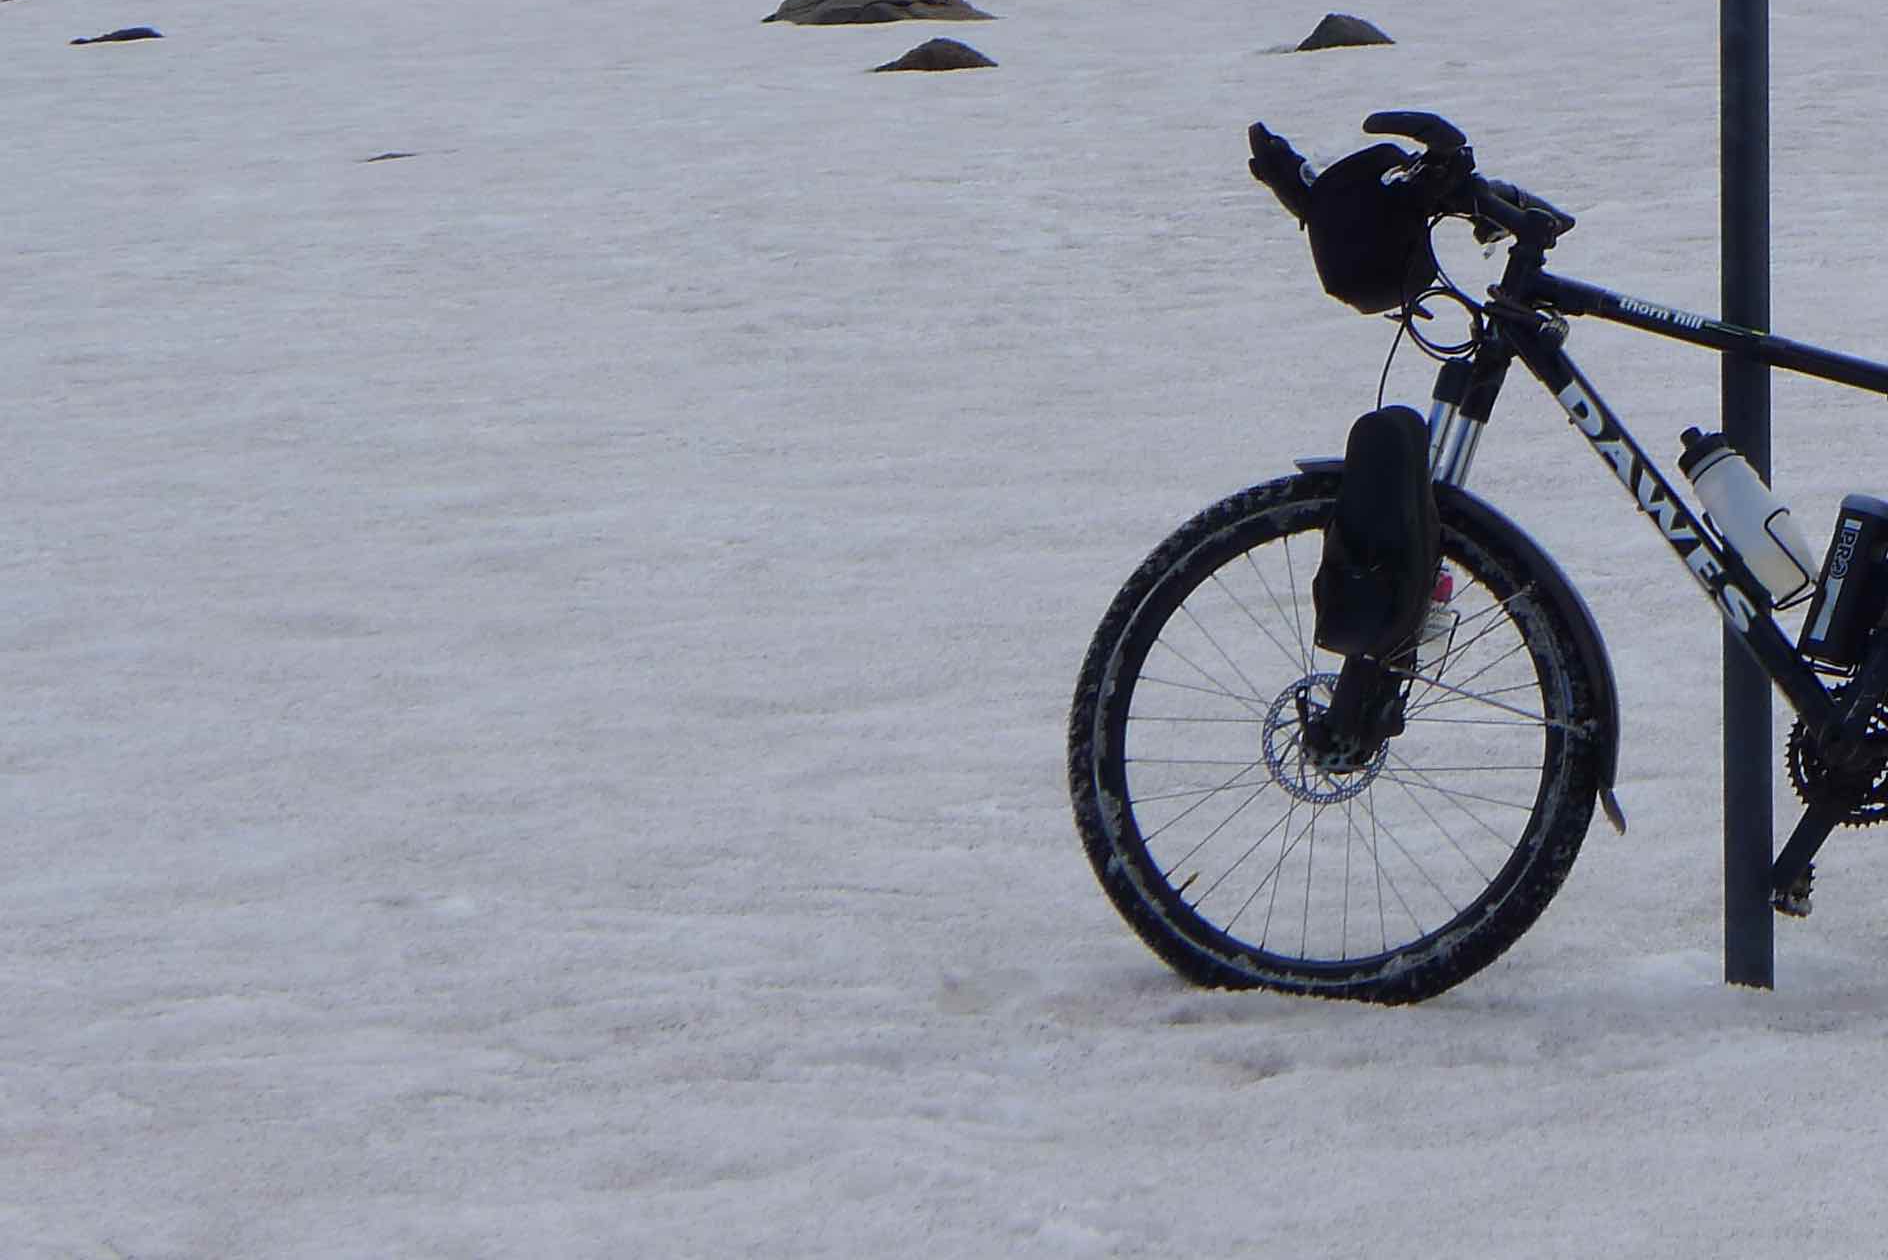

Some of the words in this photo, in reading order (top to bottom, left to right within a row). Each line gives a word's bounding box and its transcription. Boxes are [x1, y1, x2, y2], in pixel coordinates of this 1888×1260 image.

[1619, 296, 1670, 321] thorn
[1671, 309, 1703, 330] hill
[1558, 380, 1757, 633] DAWES
